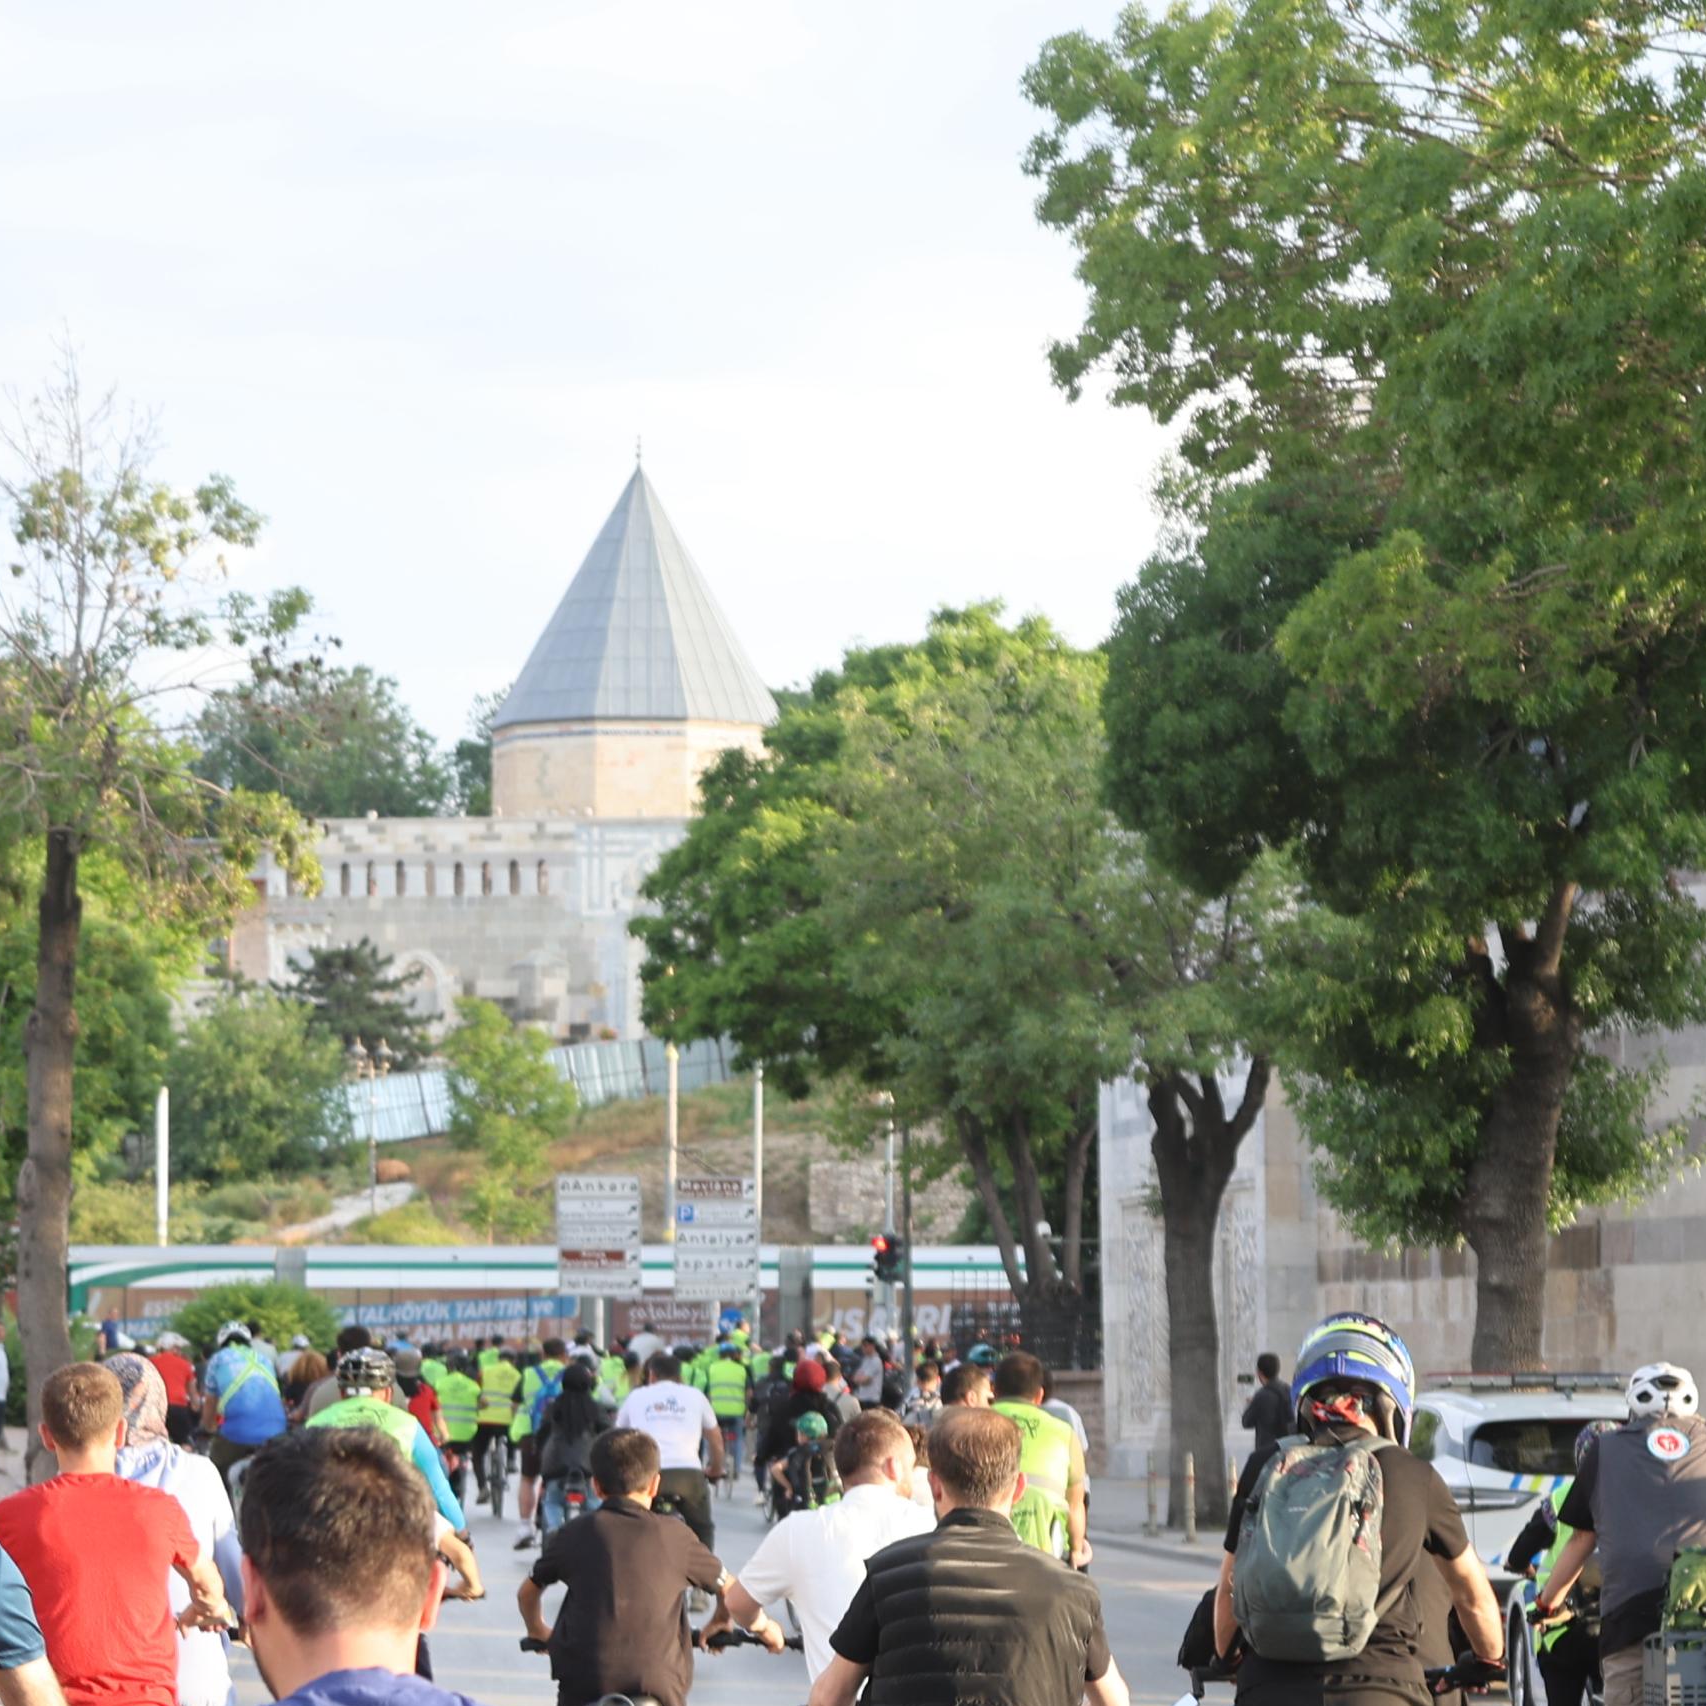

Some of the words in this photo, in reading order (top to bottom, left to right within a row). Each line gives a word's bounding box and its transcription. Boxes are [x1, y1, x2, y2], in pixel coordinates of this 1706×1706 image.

[572, 1179, 638, 1193] Ankara
[678, 1232, 743, 1248] Antalya
[676, 1257, 743, 1271] Isparta
